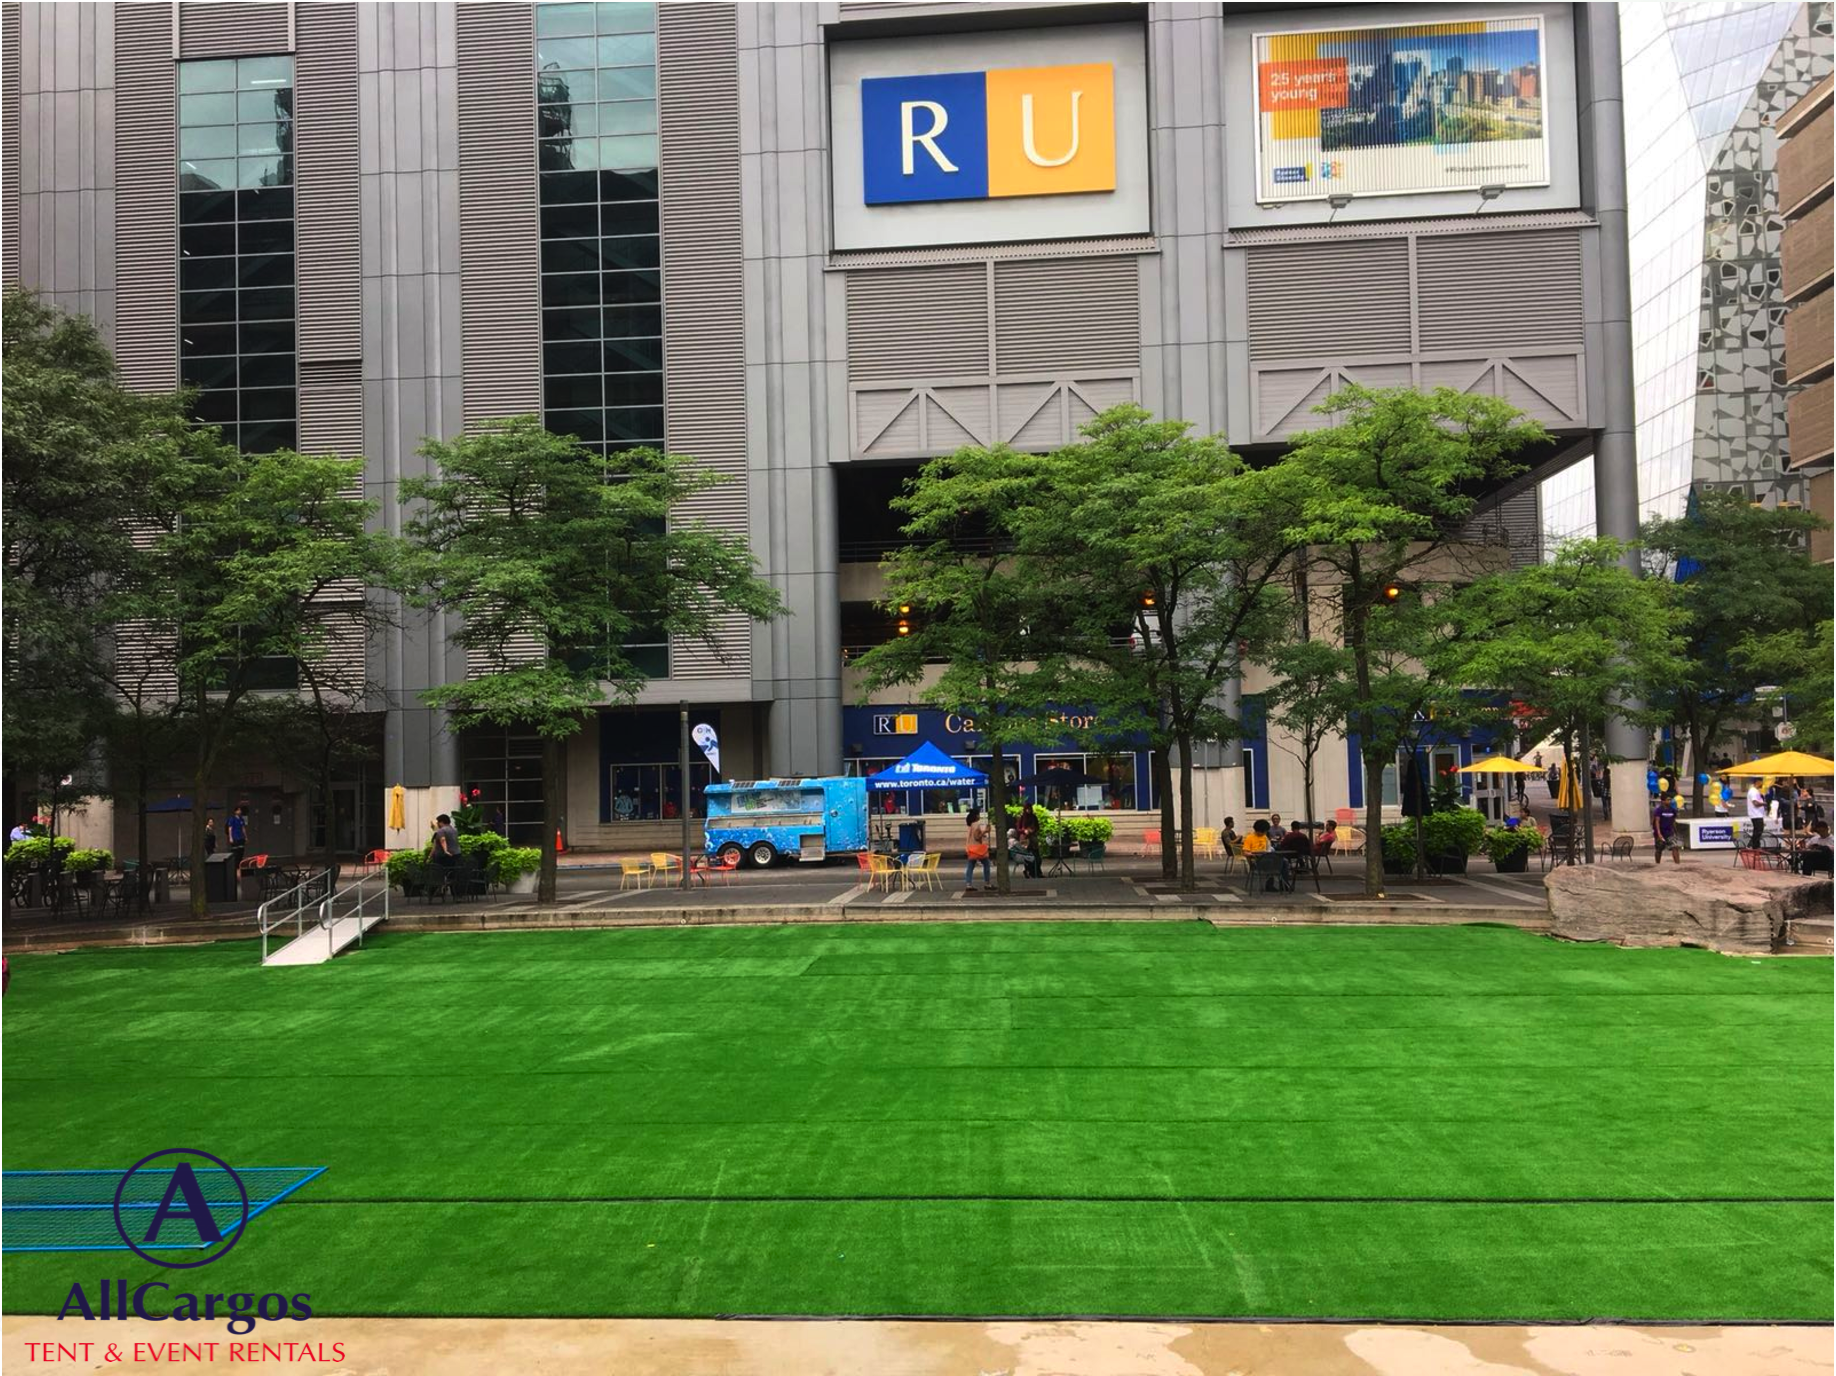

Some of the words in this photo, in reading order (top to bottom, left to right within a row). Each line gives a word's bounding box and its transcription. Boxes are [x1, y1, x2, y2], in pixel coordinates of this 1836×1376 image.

[1270, 72, 1290, 87] 25
[1294, 72, 1336, 87] years
[1270, 88, 1318, 103] young
[874, 778, 975, 789] www.toronto.ca/water
